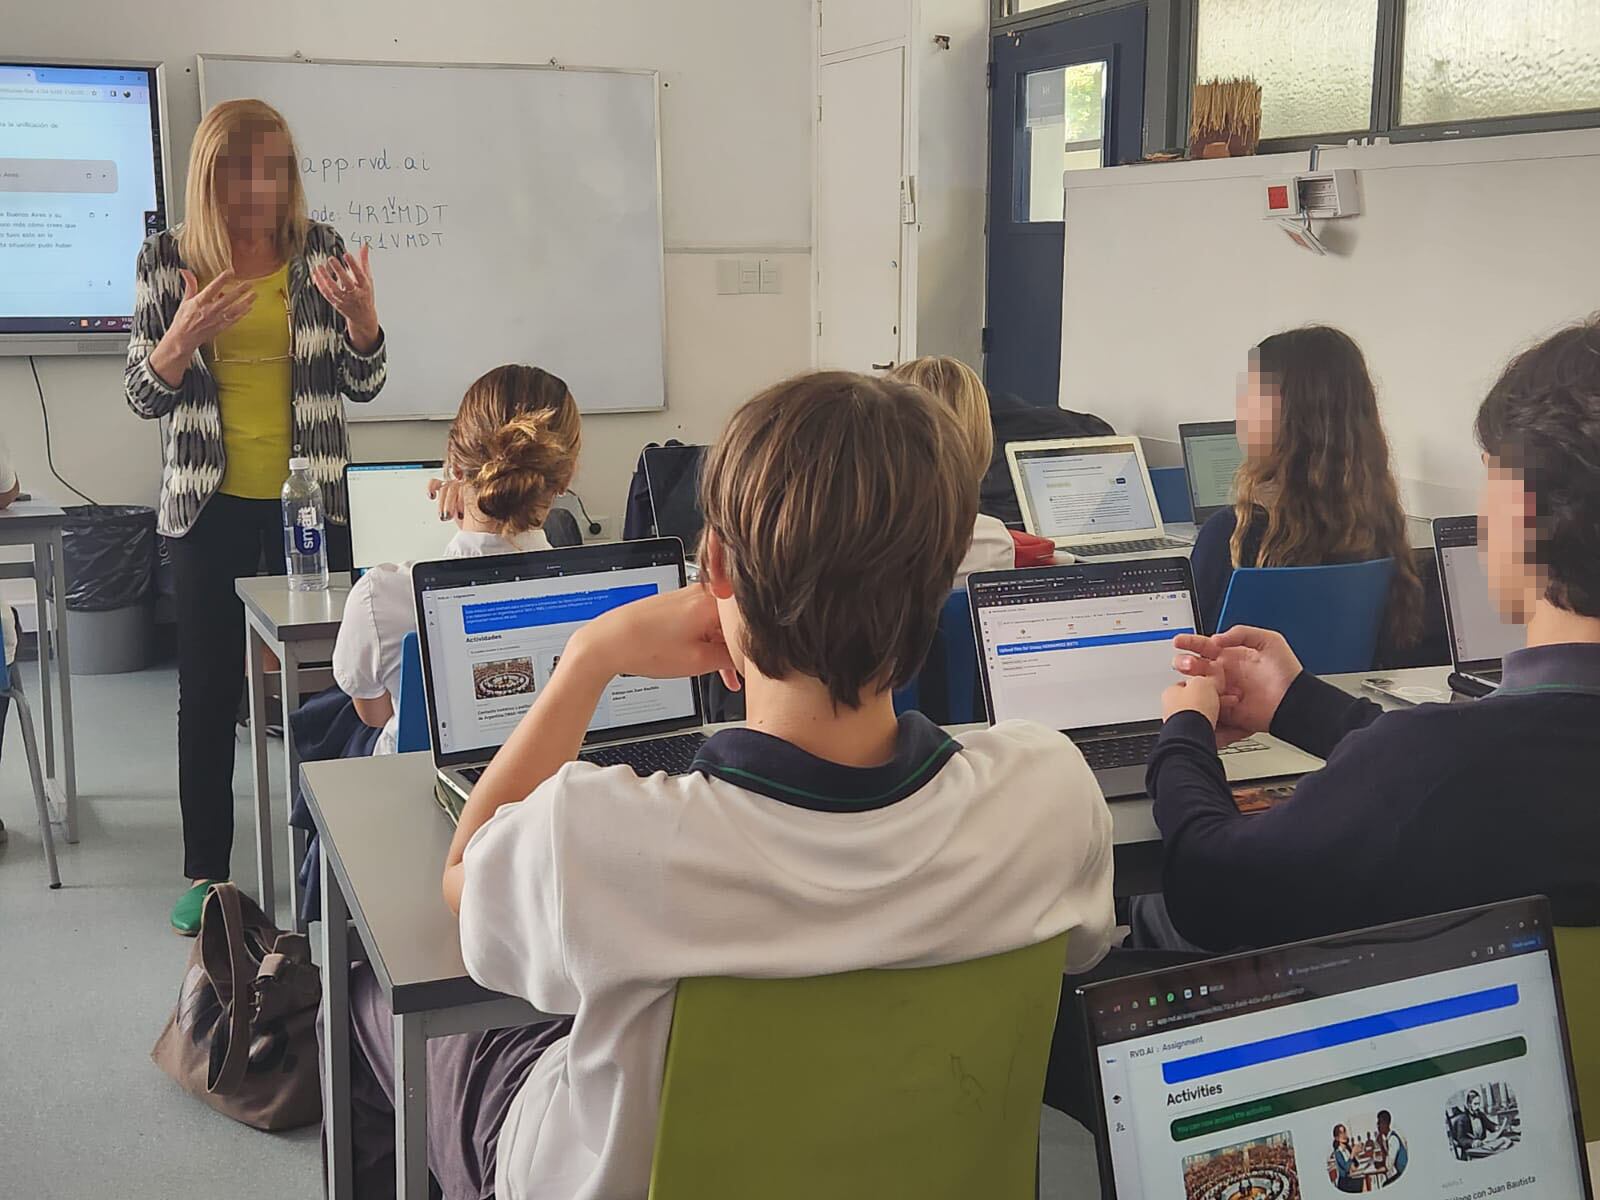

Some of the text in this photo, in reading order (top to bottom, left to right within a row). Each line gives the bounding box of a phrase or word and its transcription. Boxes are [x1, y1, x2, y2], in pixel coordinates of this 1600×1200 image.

[465, 634, 502, 643] Actividades
[1162, 1035, 1204, 1052] Assignment
[1166, 1084, 1223, 1107] Activities
[1473, 1191, 1486, 1200] con
[1487, 1184, 1506, 1195] Juan
[1506, 1176, 1536, 1190] Bautista
